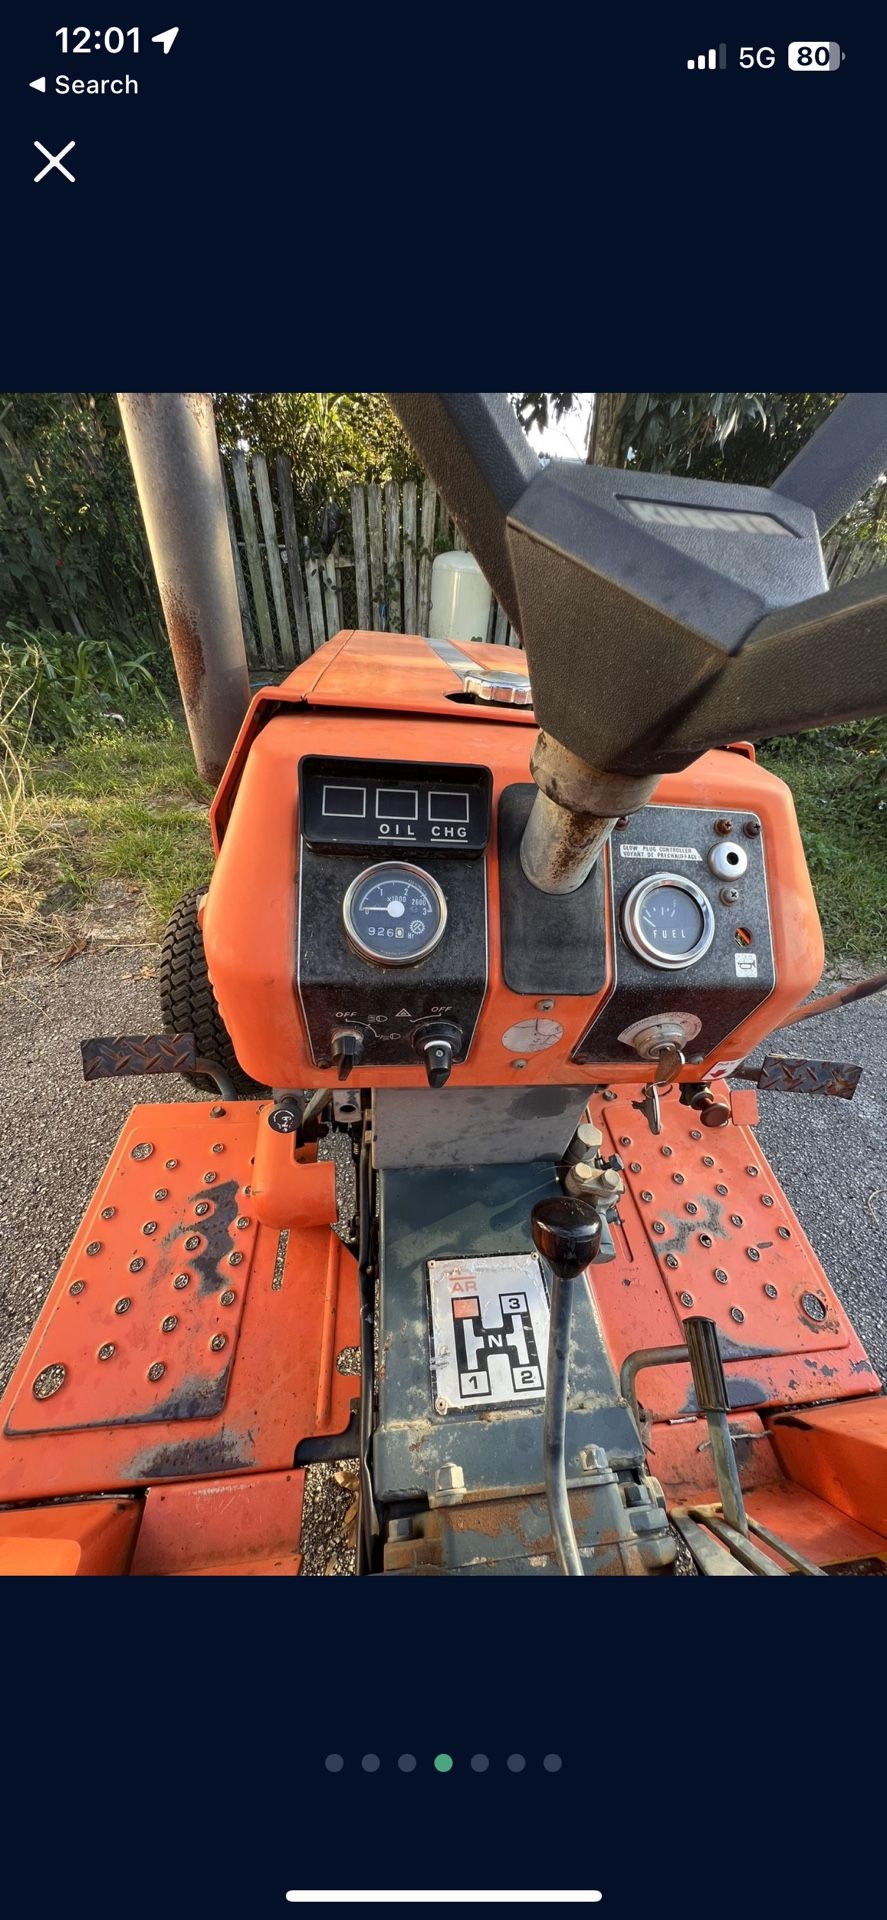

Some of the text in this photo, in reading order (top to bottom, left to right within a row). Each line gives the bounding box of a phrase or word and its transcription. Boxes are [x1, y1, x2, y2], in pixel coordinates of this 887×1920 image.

[379, 824, 467, 838] OIL CHG
[653, 930, 686, 938] FUEL
[452, 1281, 477, 1292] AR
[508, 1298, 520, 1309] 3
[488, 1335, 502, 1347] N
[469, 1376, 478, 1389] 1
[521, 1371, 534, 1384] 2
